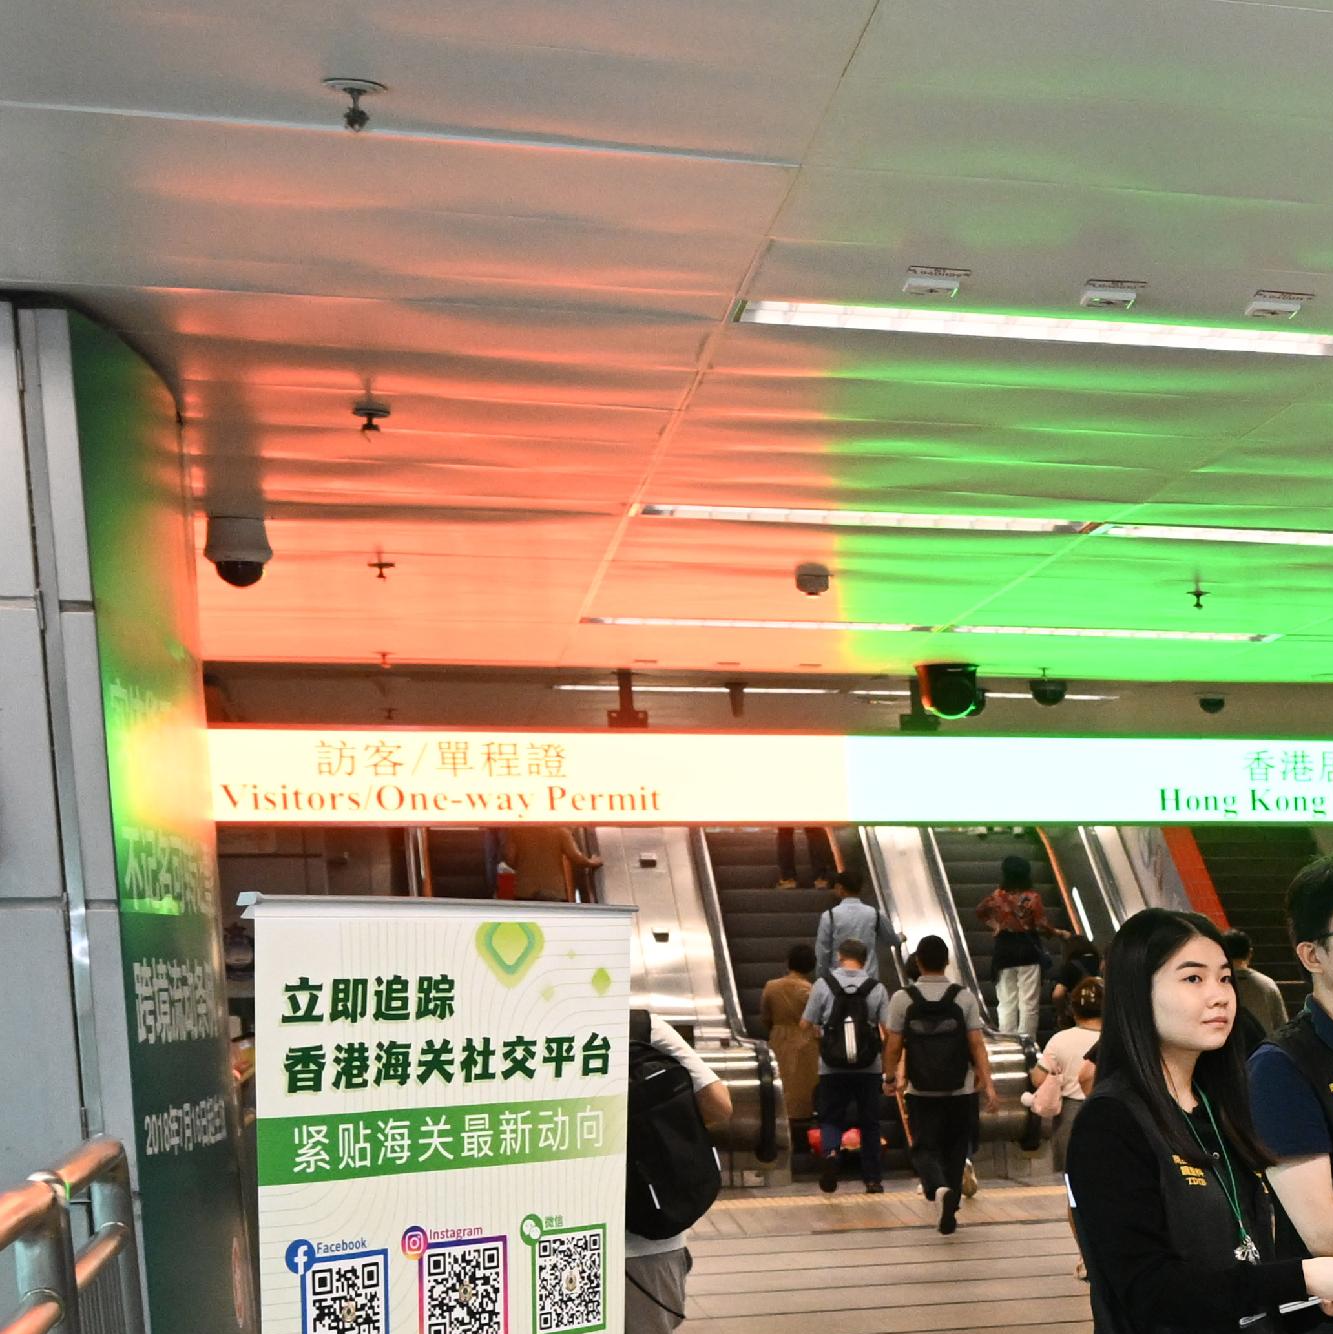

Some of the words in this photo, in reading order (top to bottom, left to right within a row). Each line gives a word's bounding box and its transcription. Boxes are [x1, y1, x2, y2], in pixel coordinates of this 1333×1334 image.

[315, 739, 568, 779] 訪客/單程證
[219, 783, 533, 818] Visitors/One-way
[545, 785, 662, 811] Permit
[1159, 788, 1239, 817] Hong
[1249, 788, 1328, 816] Kong
[280, 974, 455, 1024] 立即追踪
[284, 1032, 612, 1094] 香港海关社交平台
[292, 1105, 605, 1174] 紧贴海关最新动向
[429, 1226, 484, 1240] Instagram
[545, 1215, 564, 1228] 微信
[316, 1237, 367, 1254] Facebook
